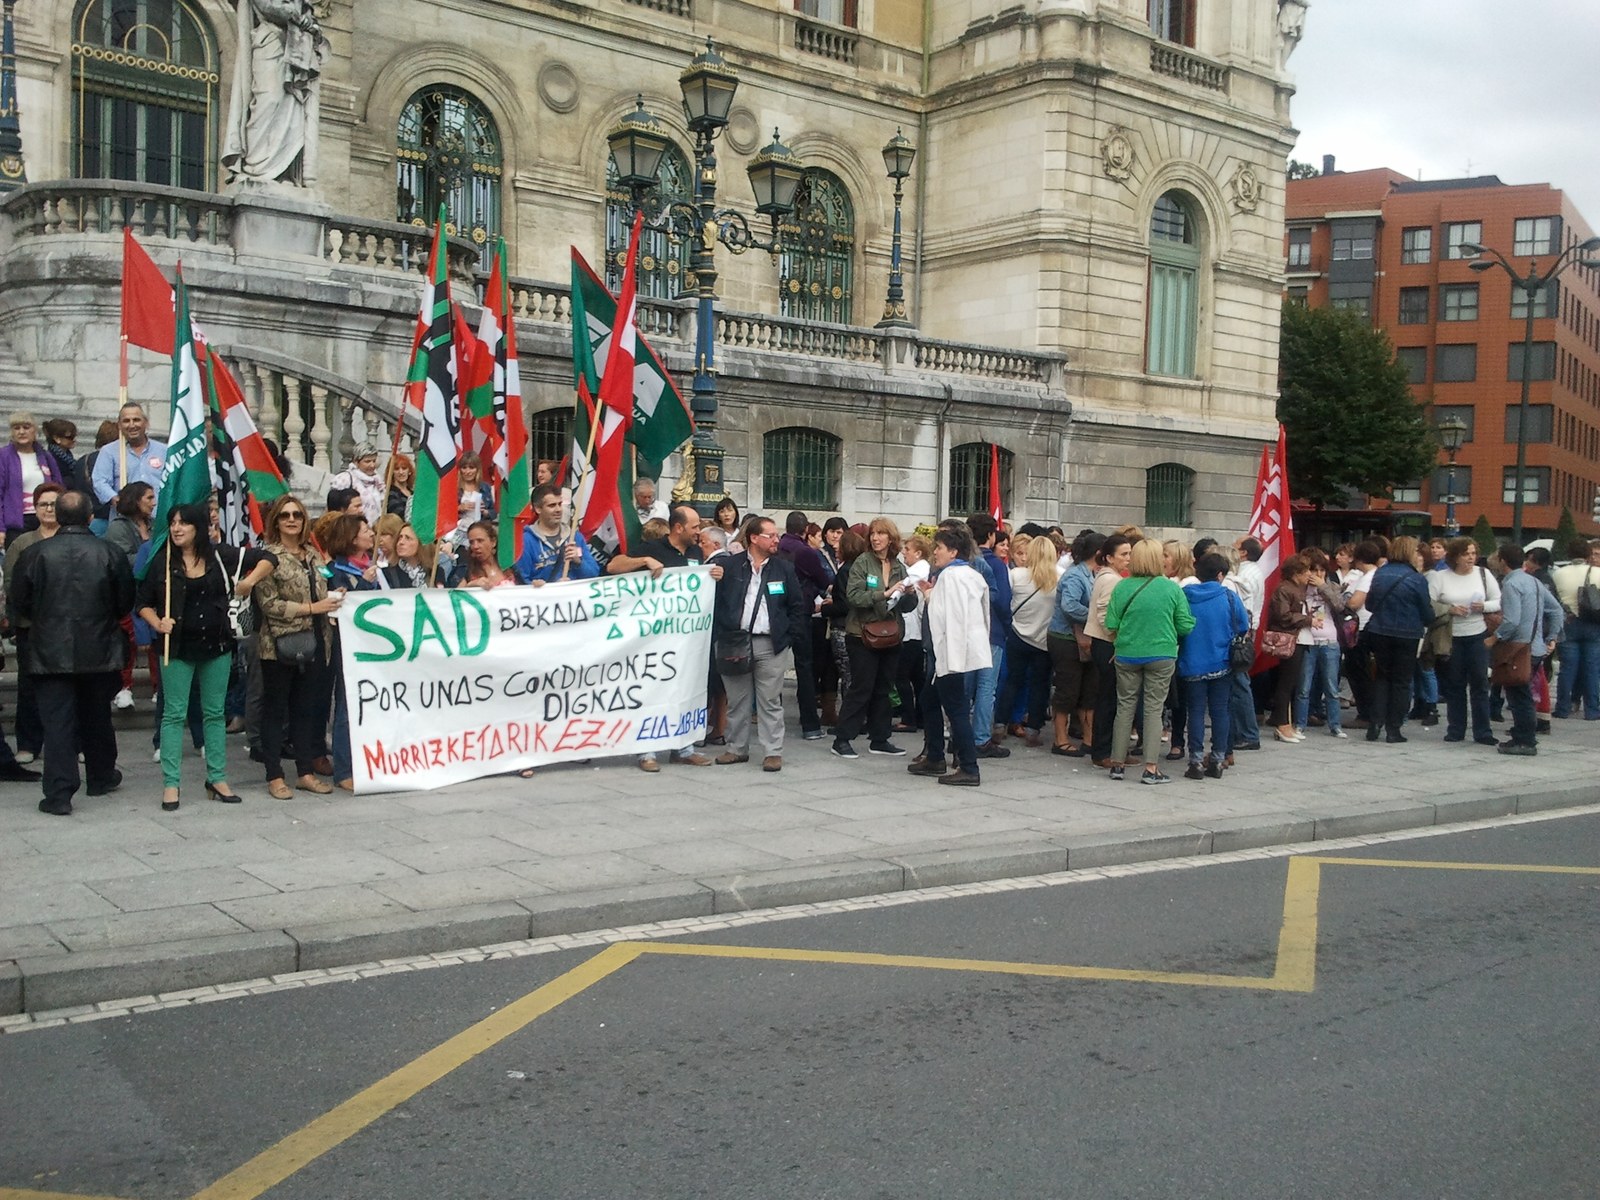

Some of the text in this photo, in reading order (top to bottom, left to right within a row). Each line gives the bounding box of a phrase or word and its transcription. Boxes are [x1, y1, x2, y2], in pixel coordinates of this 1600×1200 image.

[589, 572, 702, 599] SERVICIO
[593, 594, 701, 619] DE AYUDA
[353, 589, 589, 662] SAD BIZKAIA
[606, 613, 712, 640] A DOMICILIO
[357, 651, 677, 726] POR UNAS CONDICIONES
[543, 685, 643, 722] DIGNAS
[363, 722, 548, 780] MURRIZKETARIK
